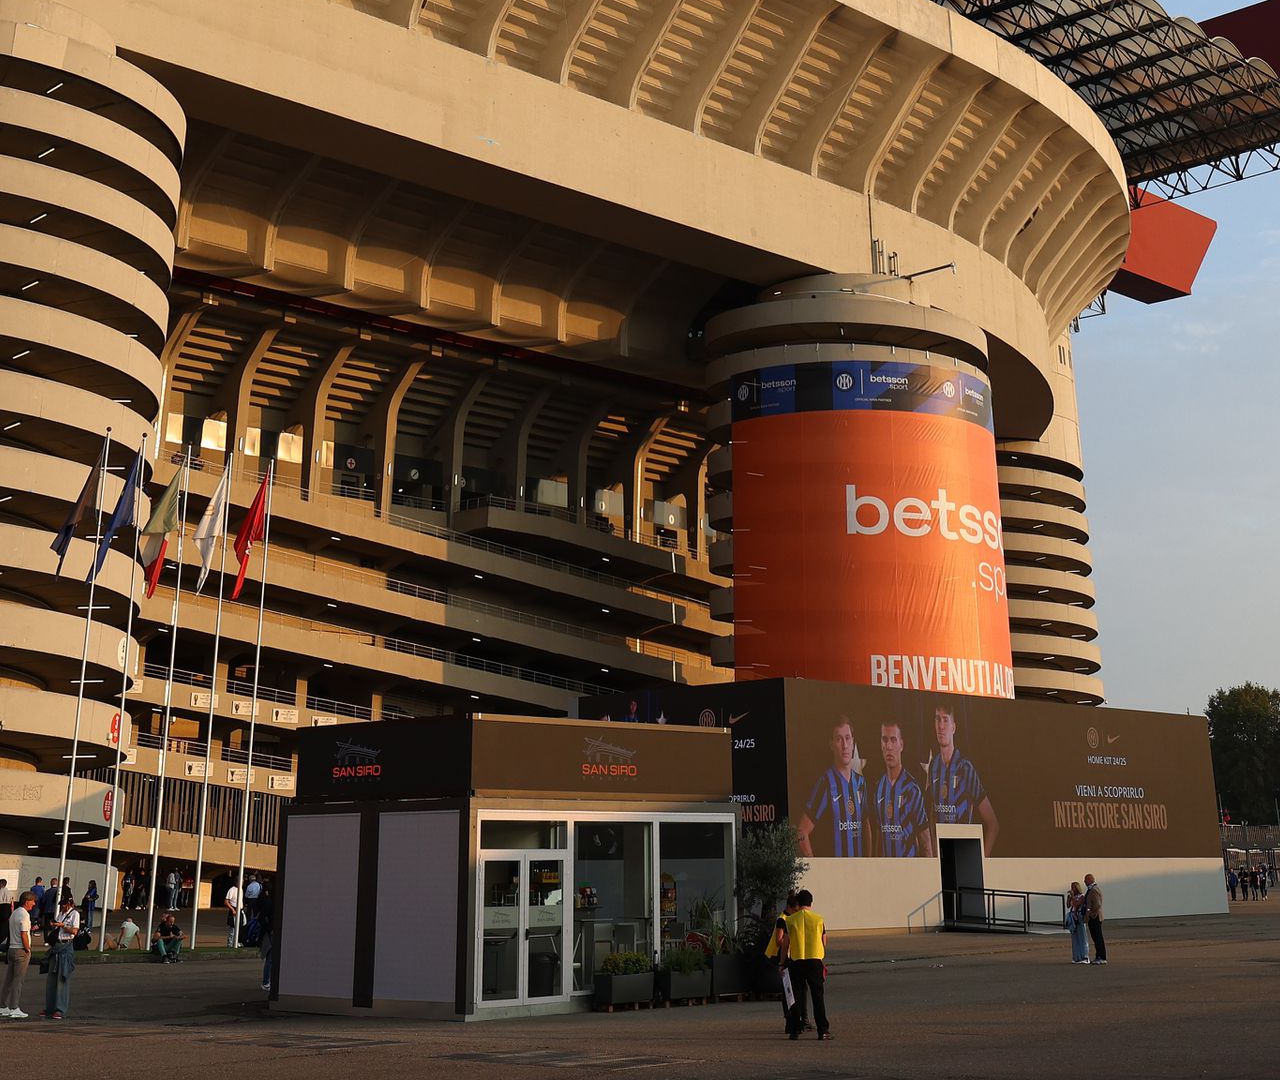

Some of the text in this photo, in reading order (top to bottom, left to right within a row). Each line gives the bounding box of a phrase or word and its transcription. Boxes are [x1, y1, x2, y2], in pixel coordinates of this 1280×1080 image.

[761, 379, 797, 389] betsson
[870, 374, 909, 384] betsson
[964, 387, 984, 402] betsson
[870, 654, 992, 696] BENVENUTI
[734, 739, 756, 749] 24/25
[1087, 755, 1127, 766] HOME KIT 24/25
[332, 764, 381, 778] SAN SIRO
[582, 763, 637, 777] SAN SIRO
[1075, 785, 1145, 799] VIENI A SCOPRIRLO
[754, 804, 775, 822] SIRO
[1053, 801, 1168, 830] INTER STORE SAN SIRO
